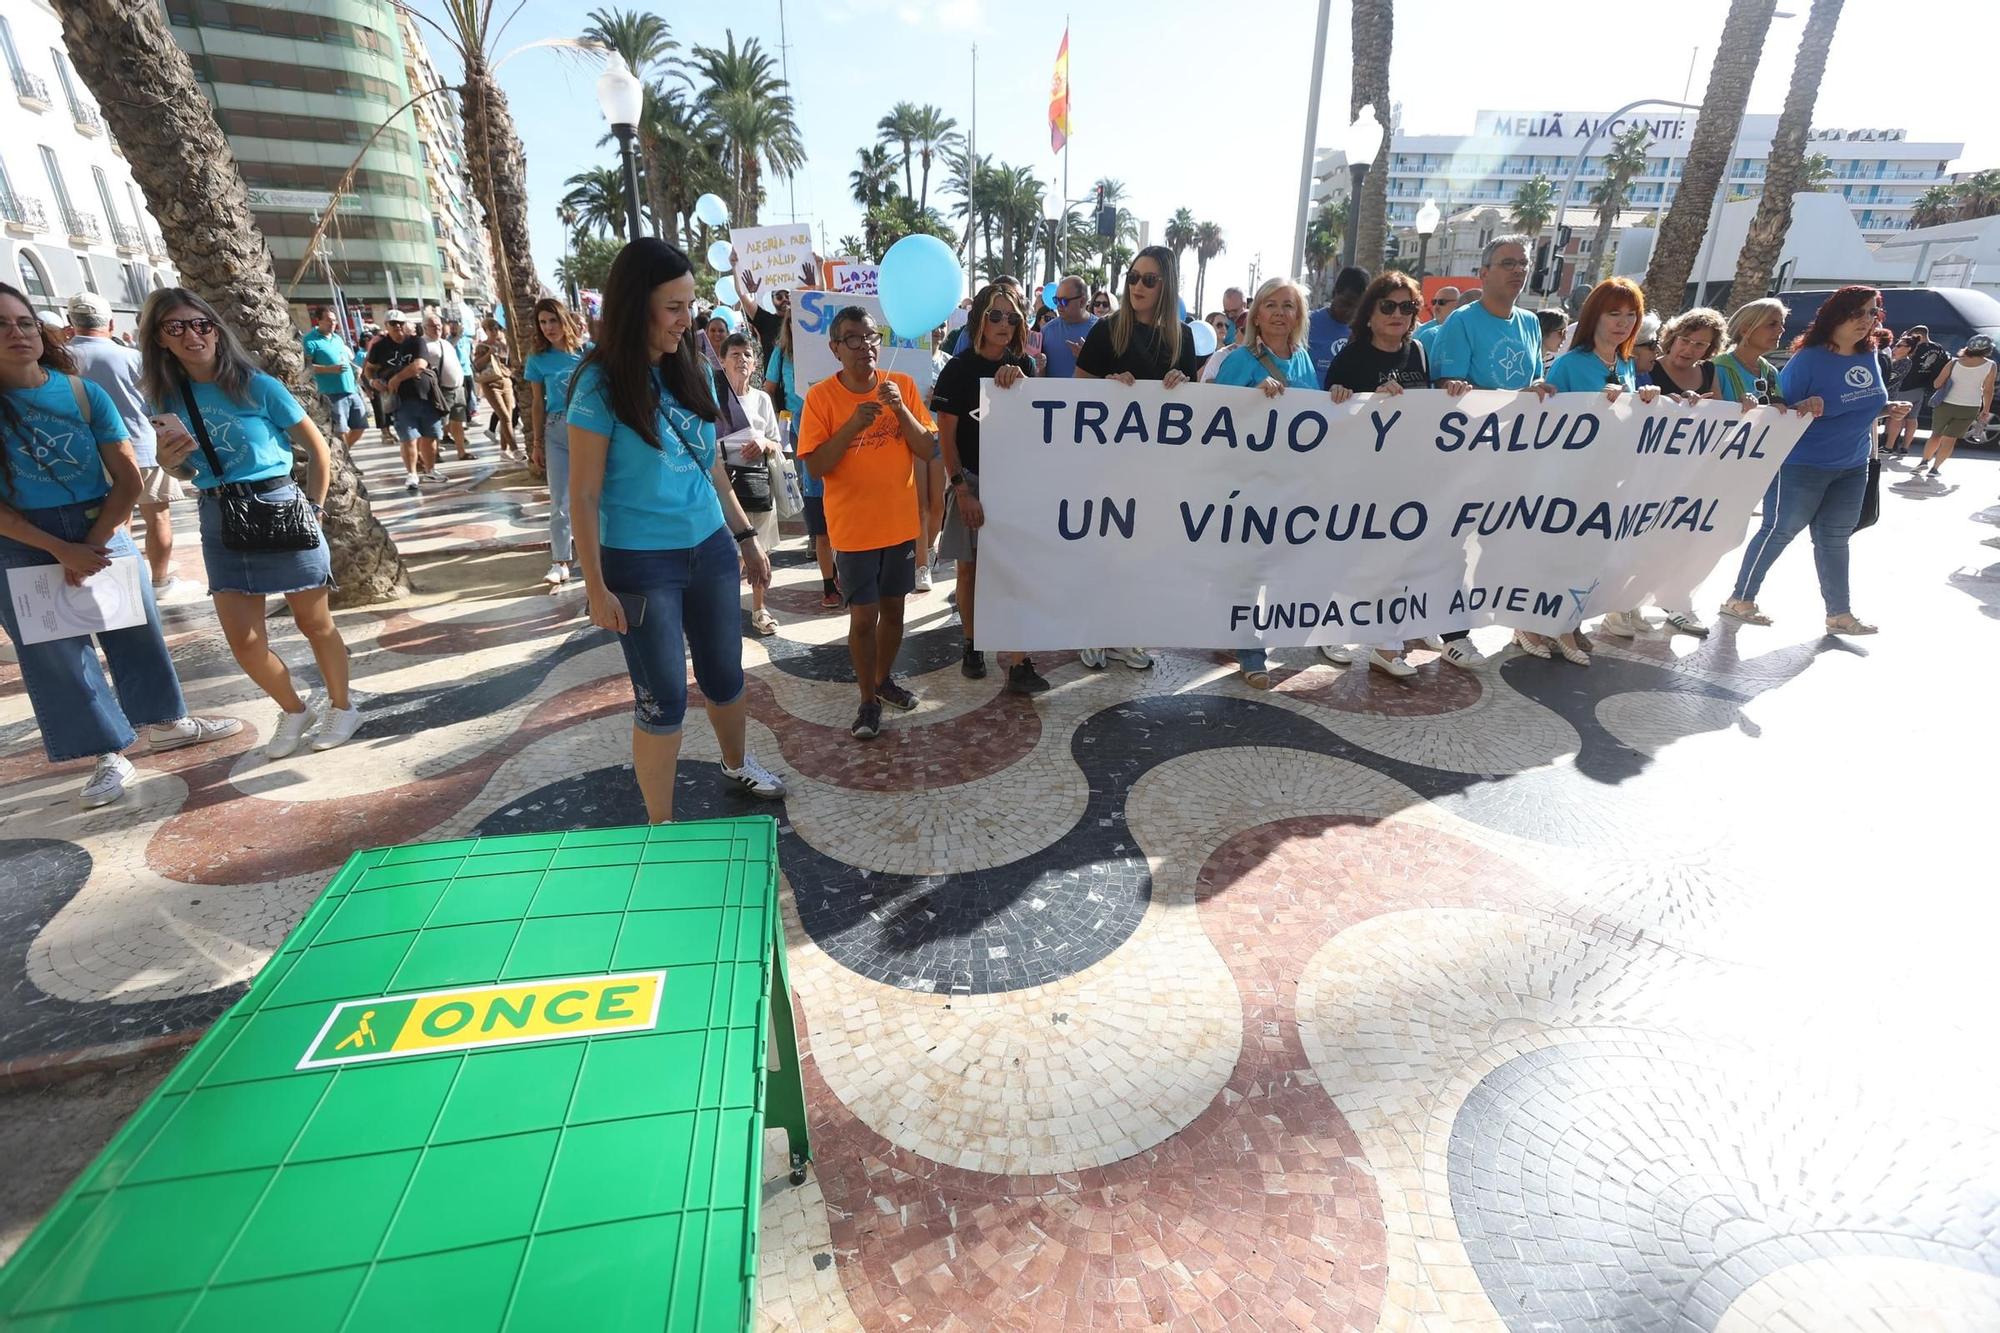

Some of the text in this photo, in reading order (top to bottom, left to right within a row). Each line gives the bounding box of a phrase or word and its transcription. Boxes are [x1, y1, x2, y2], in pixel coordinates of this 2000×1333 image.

[751, 253, 797, 271] LA SALUD
[1031, 400, 1772, 461] TRABAJO Y SALUD MENTAL
[1057, 490, 1719, 545] UN VÍNCULO FUNDAMENTAL
[1230, 586, 1564, 632] FUNDACIÓN ADIEM
[421, 984, 640, 1038] ONCE
